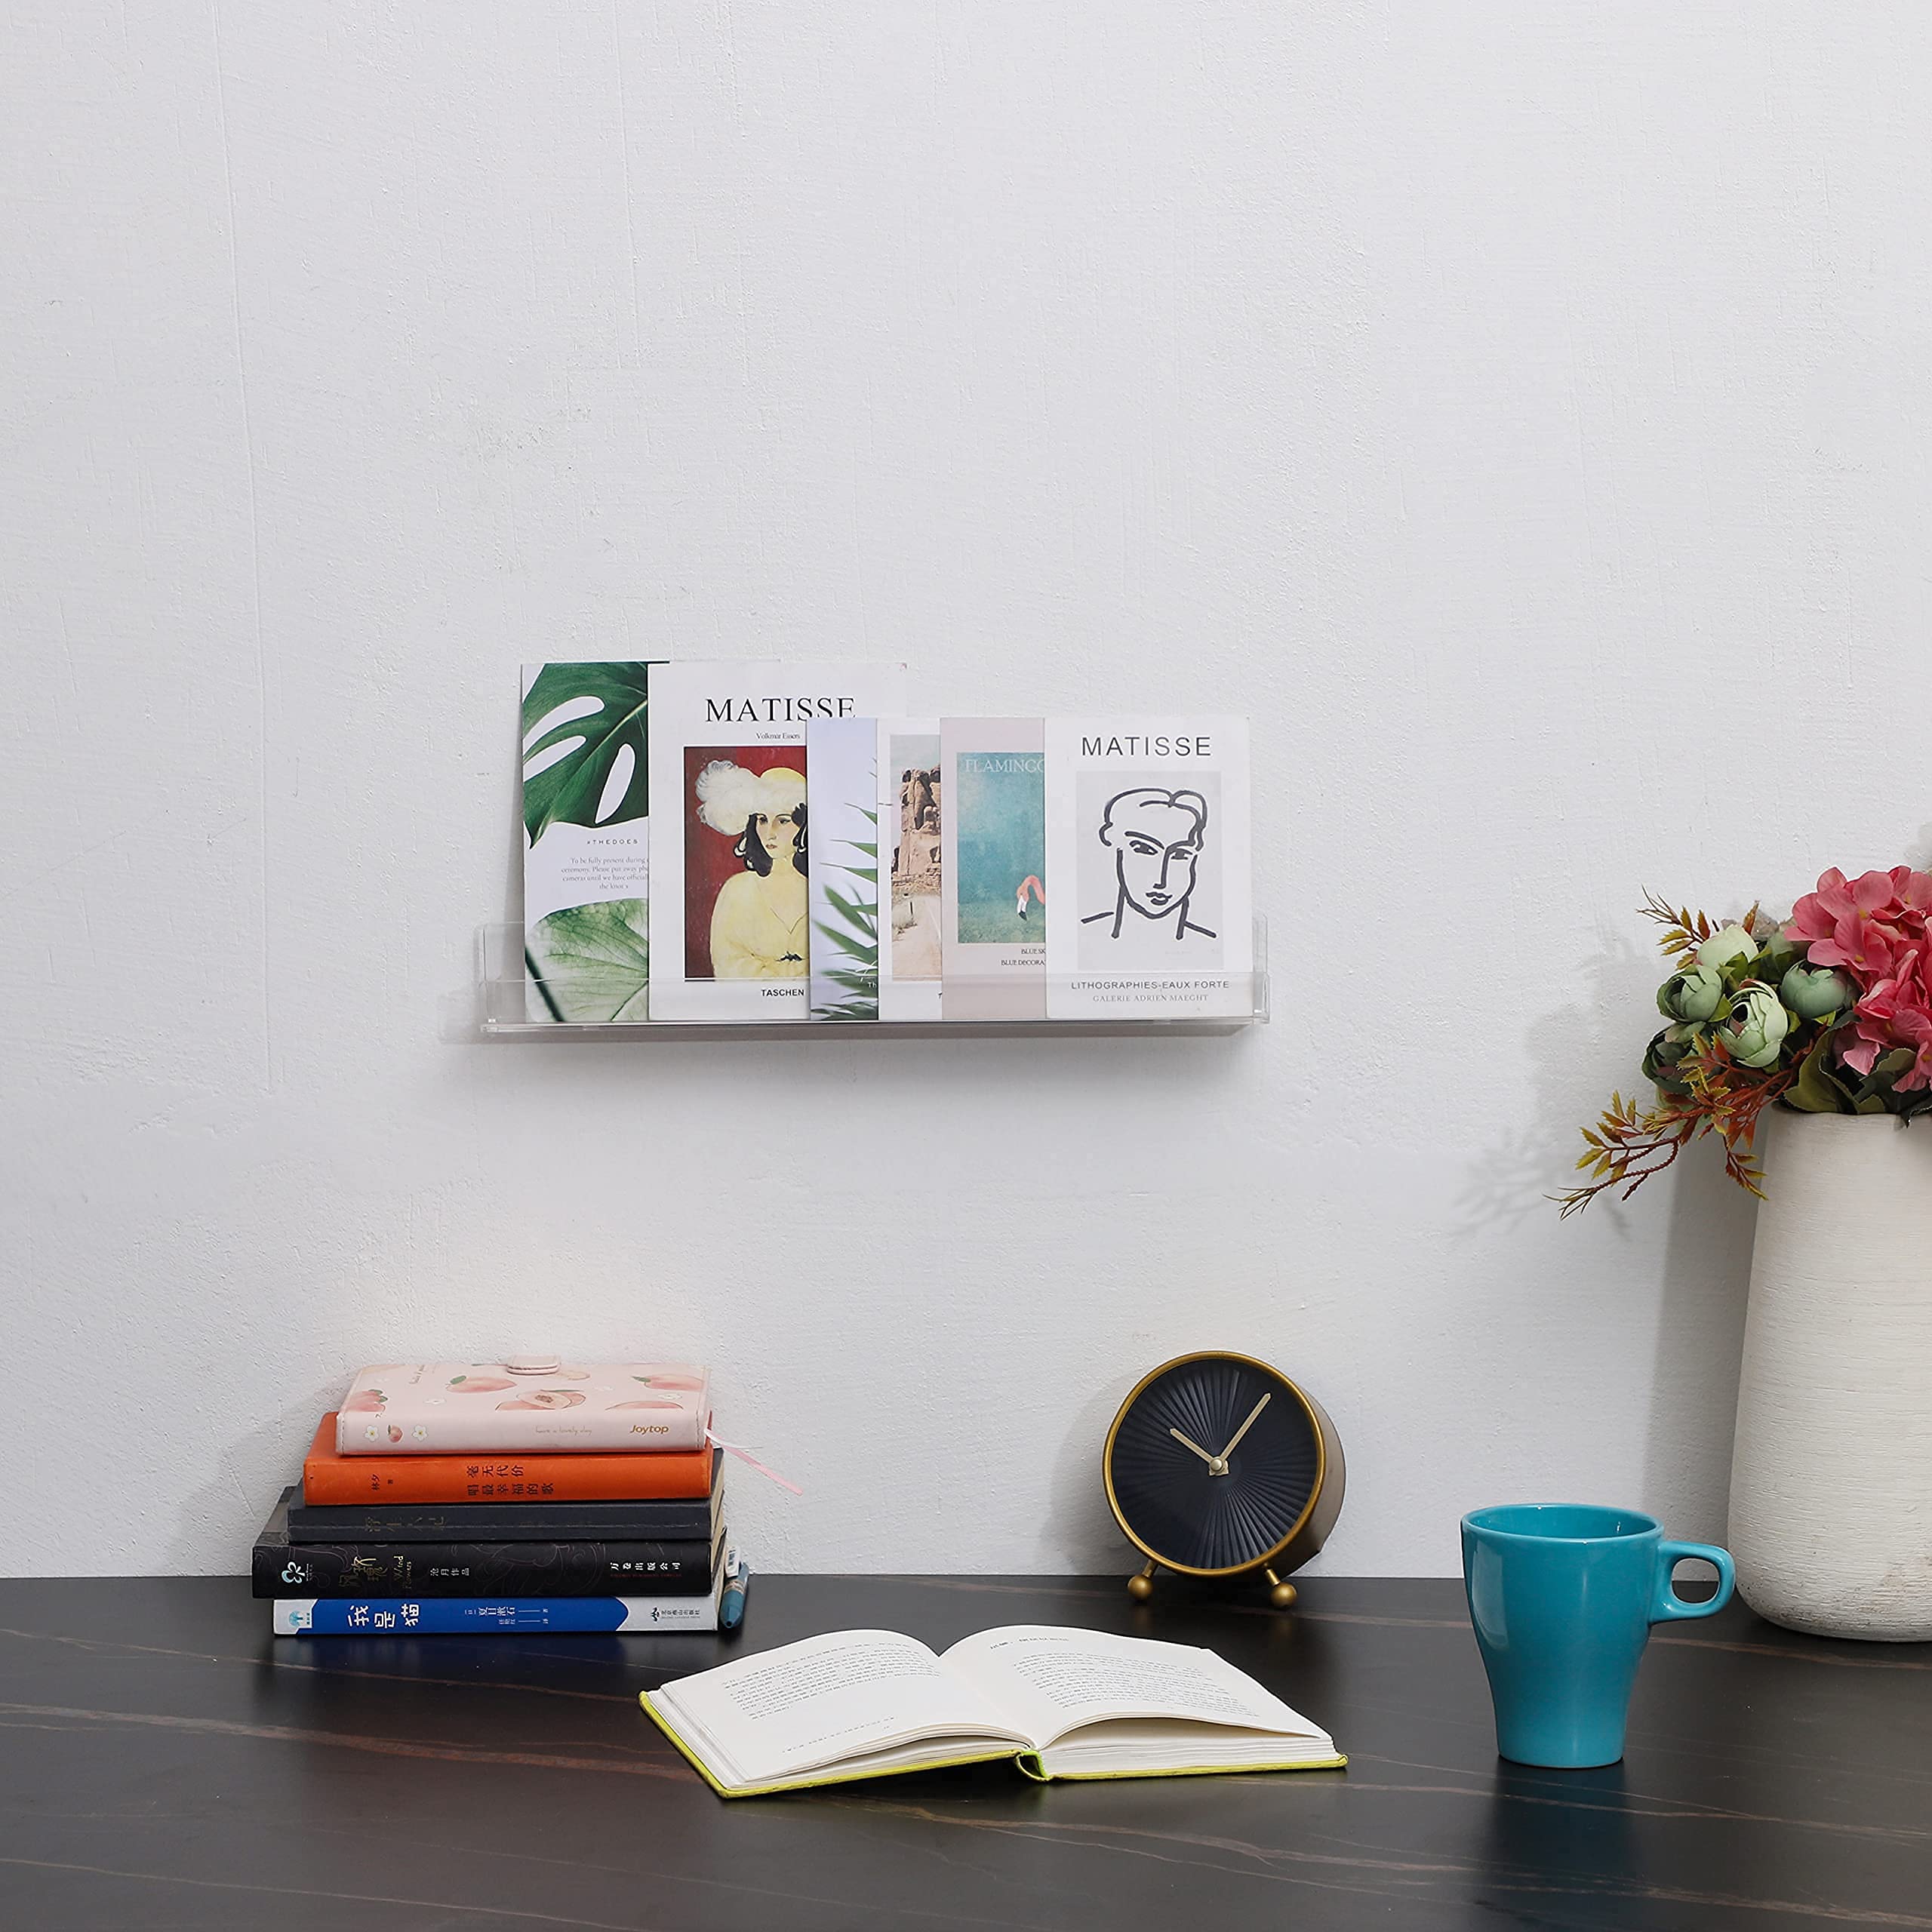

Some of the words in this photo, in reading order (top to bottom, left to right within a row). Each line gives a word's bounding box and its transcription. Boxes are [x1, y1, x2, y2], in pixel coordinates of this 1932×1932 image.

[706, 697, 856, 722] MATISSE
[1082, 737, 1211, 756] MATISSE
[761, 989, 804, 997] TASCHEN
[630, 1425, 669, 1435] Joytop
[466, 1464, 525, 1478] 毫无代价
[466, 1482, 554, 1496] 唱最幸福的歌
[347, 1603, 420, 1629] 我是猫
